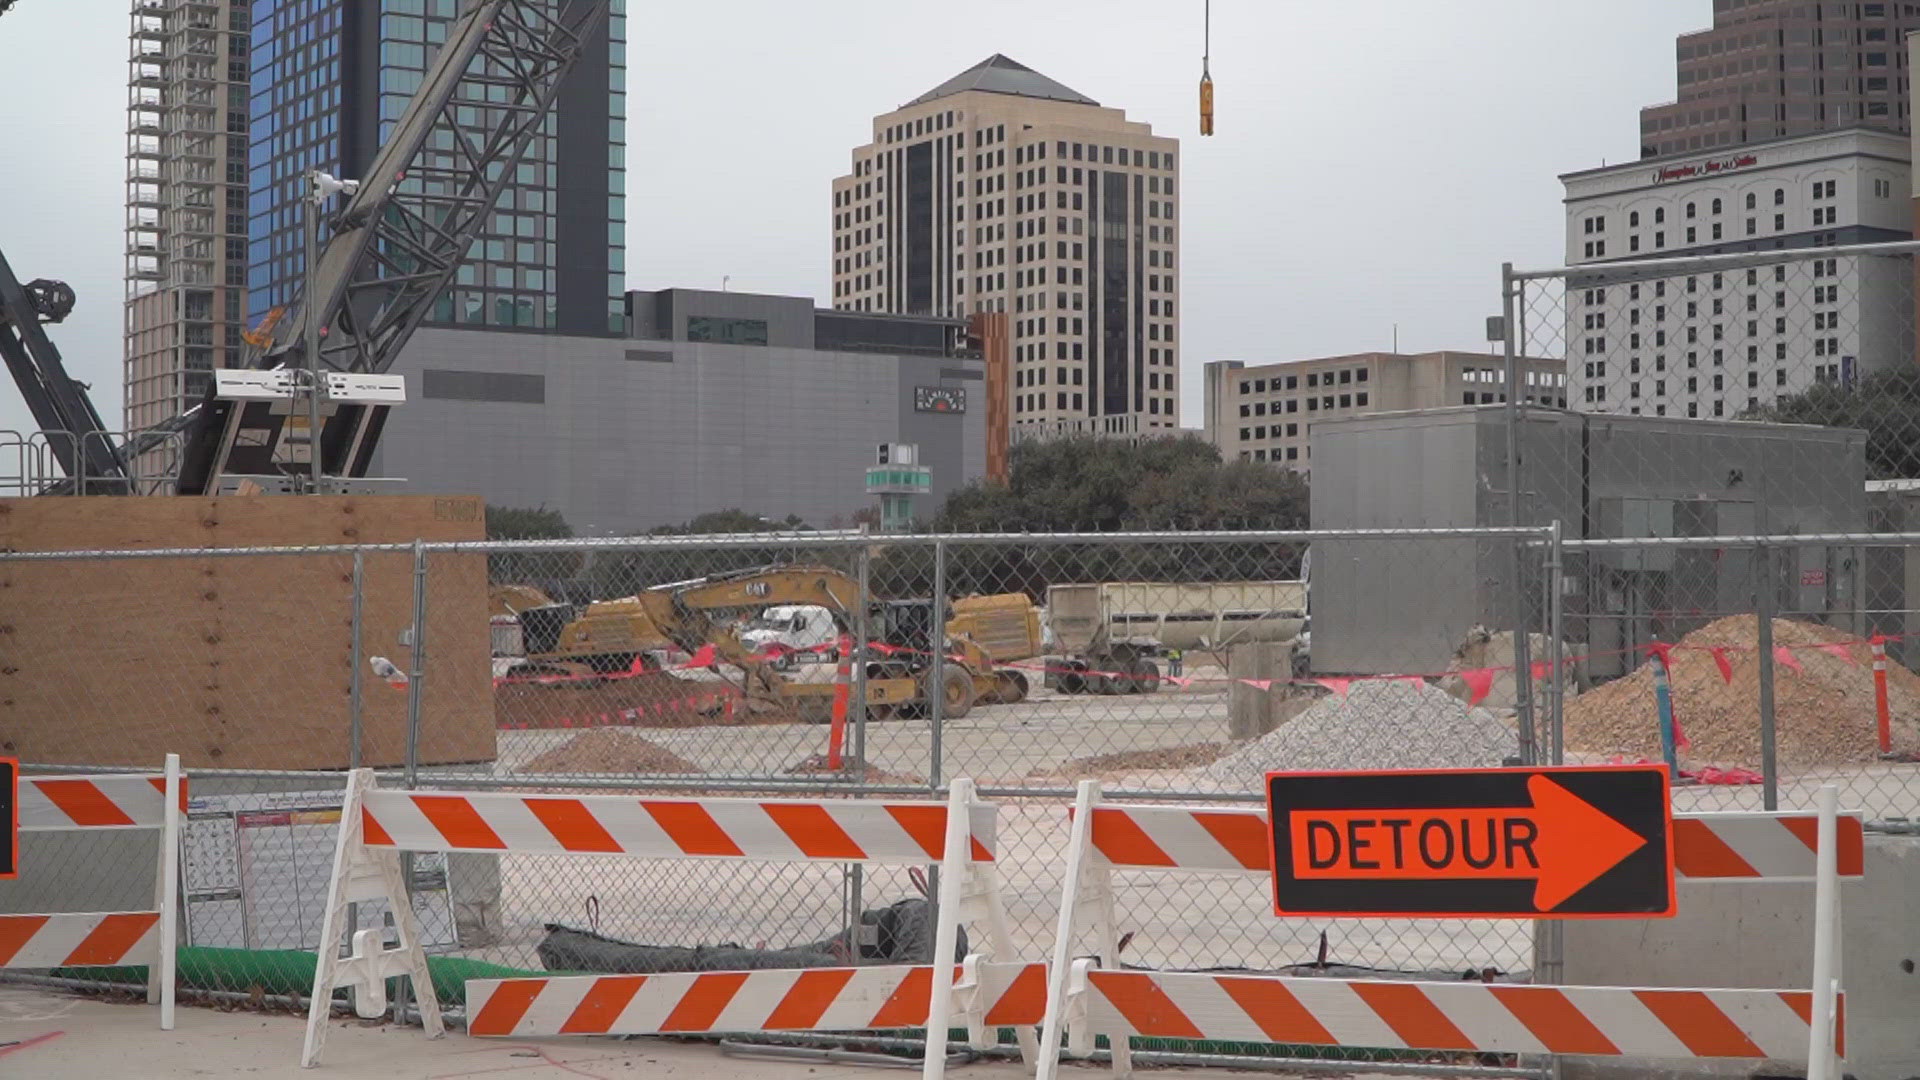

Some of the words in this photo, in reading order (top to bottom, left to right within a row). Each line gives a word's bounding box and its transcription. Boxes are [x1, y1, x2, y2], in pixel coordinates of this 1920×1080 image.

[1652, 164, 1698, 185] Hampton
[745, 582, 767, 597] CAT
[1306, 818, 1541, 870] DETOUR
